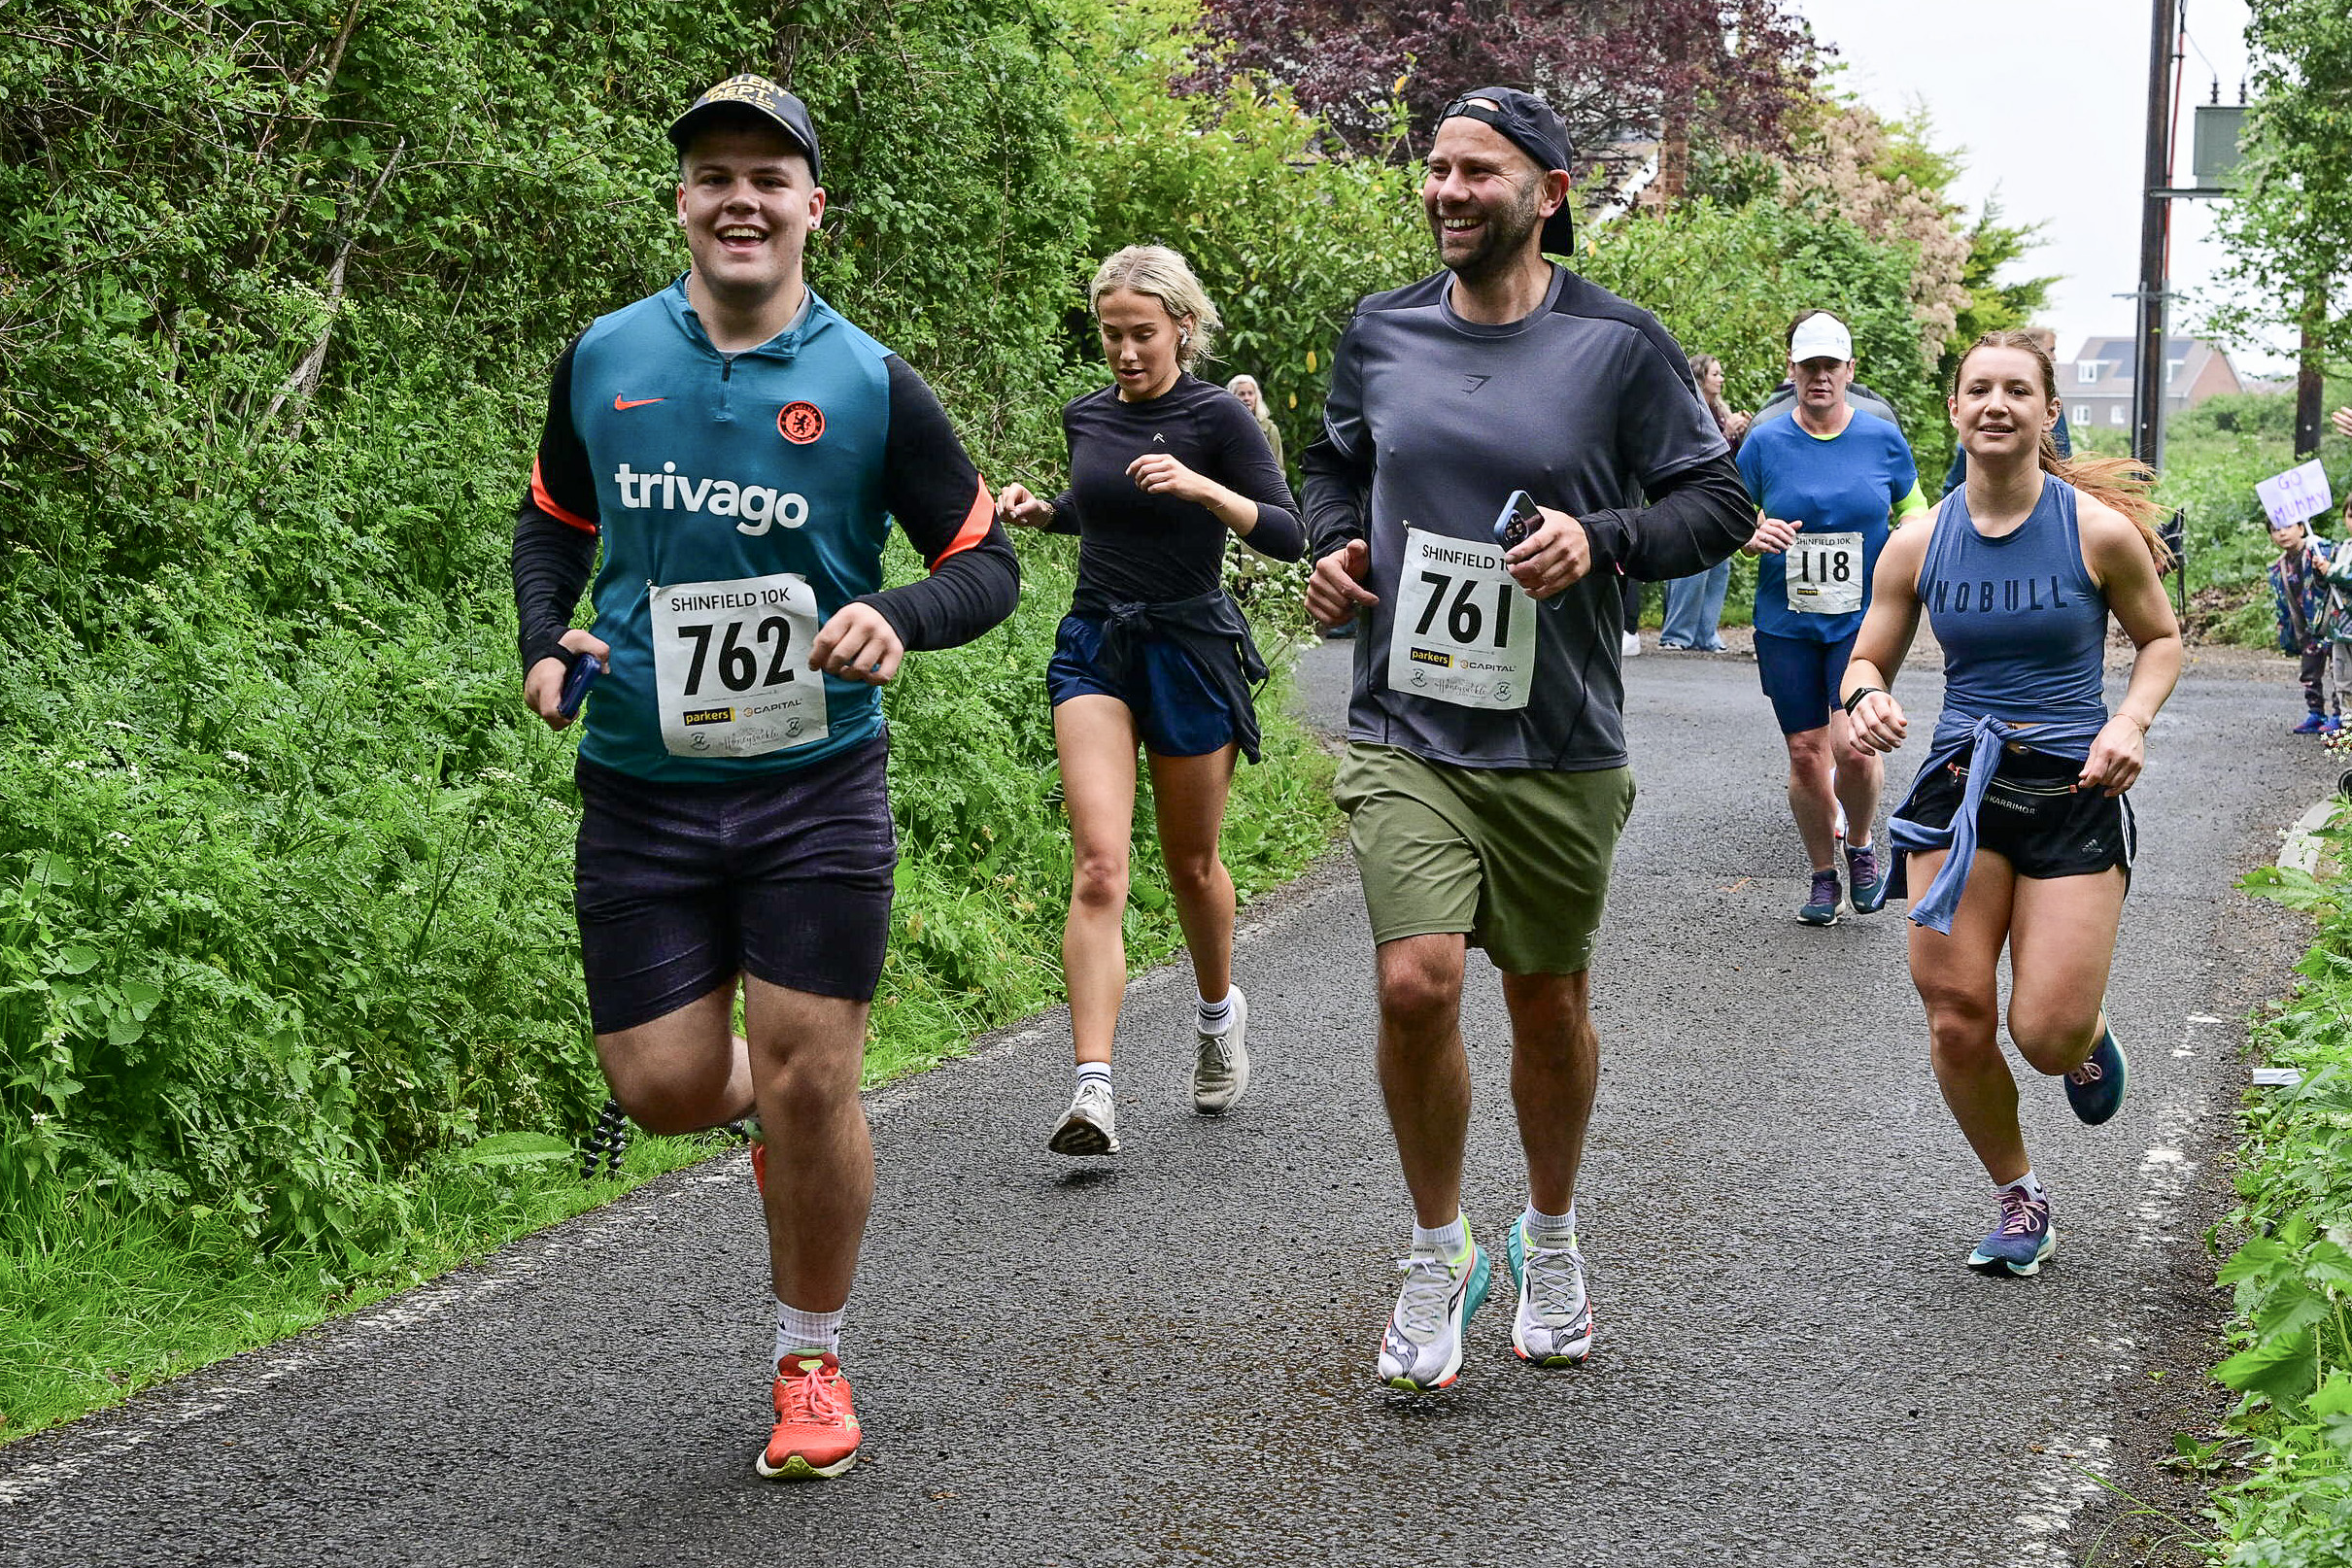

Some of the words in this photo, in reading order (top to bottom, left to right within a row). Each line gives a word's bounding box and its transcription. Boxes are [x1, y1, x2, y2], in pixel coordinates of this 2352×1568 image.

[2278, 470, 2302, 490] GO
[614, 460, 809, 536] trivago
[2273, 491, 2327, 524] MUMMY
[1795, 536, 1835, 546] SHINFIELD
[1422, 544, 1495, 569] SHINFIELD
[1802, 551, 1850, 582] 118
[671, 592, 757, 612] SHINFIELD
[761, 588, 791, 604] 10K
[1933, 575, 2067, 613] NOBULL
[1415, 570, 1513, 648] 761
[678, 616, 795, 696] 762
[1412, 650, 1449, 665] parkers
[685, 710, 729, 725] parkers
[1989, 796, 2035, 814] KARRIMOR
